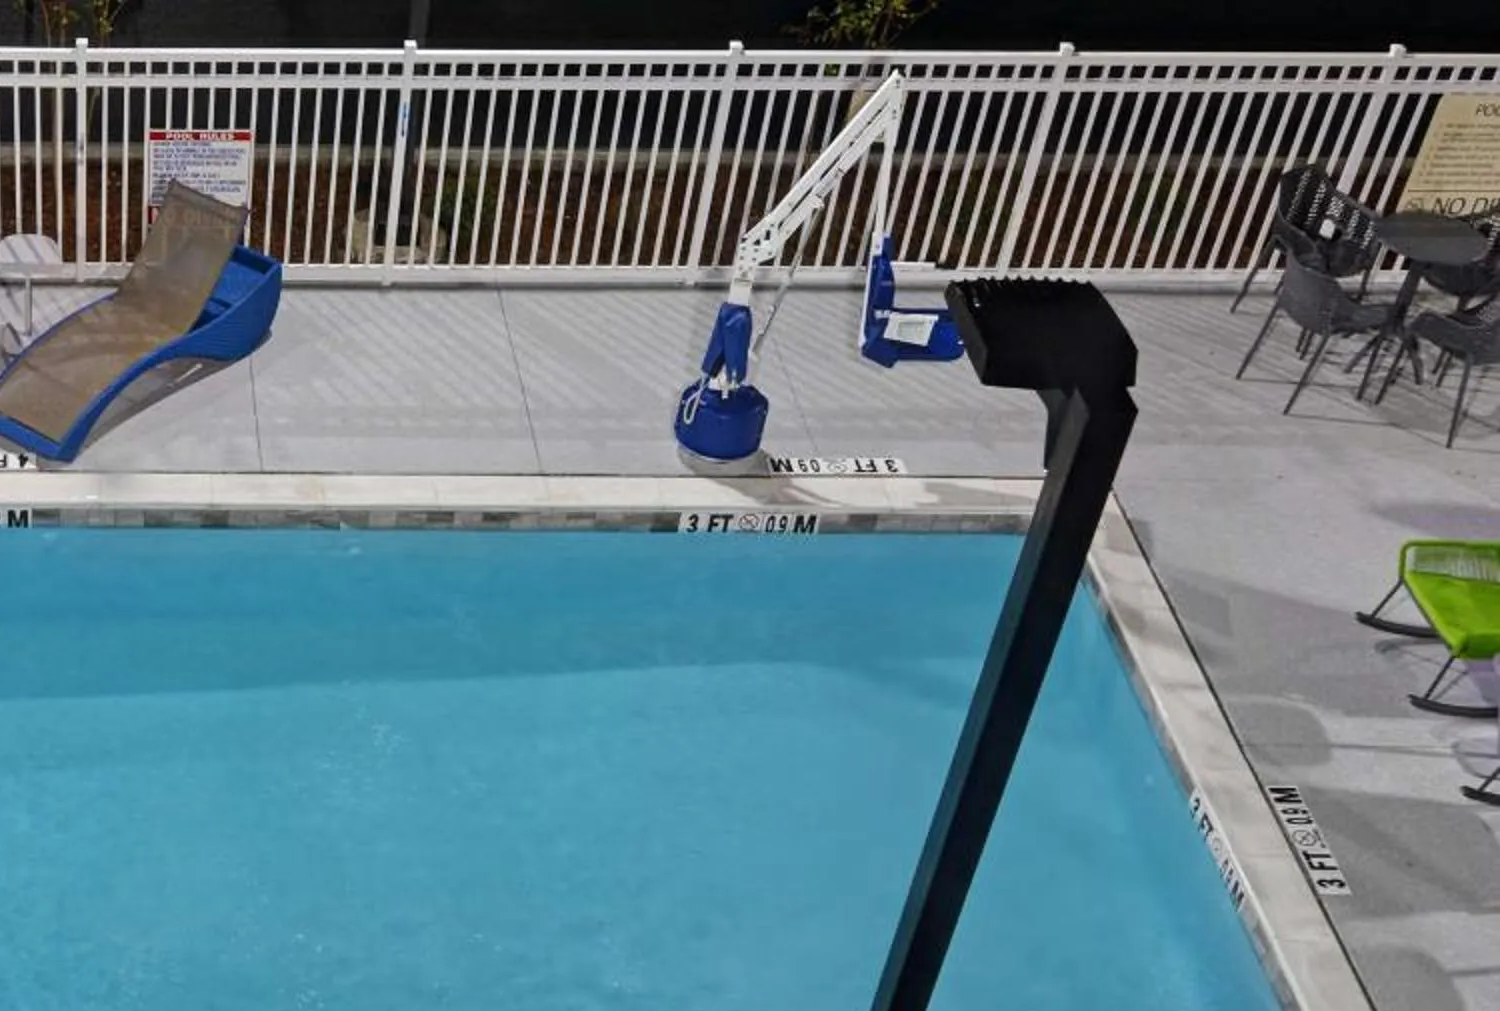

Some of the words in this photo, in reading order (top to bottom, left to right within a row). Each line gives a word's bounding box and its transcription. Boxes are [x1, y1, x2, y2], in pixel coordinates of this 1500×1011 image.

[165, 132, 194, 141] POOL
[199, 132, 235, 141] RULES
[1431, 197, 1467, 215] NO
[18, 453, 30, 468] 4
[770, 458, 794, 473] M
[854, 459, 878, 473] FT
[887, 459, 899, 473] 3
[7, 509, 29, 528] M
[686, 514, 699, 533] 3
[707, 514, 734, 533] FT
[794, 515, 818, 533] M
[1268, 787, 1303, 804] M
[1302, 850, 1339, 871] FT
[1317, 879, 1346, 889] 3
